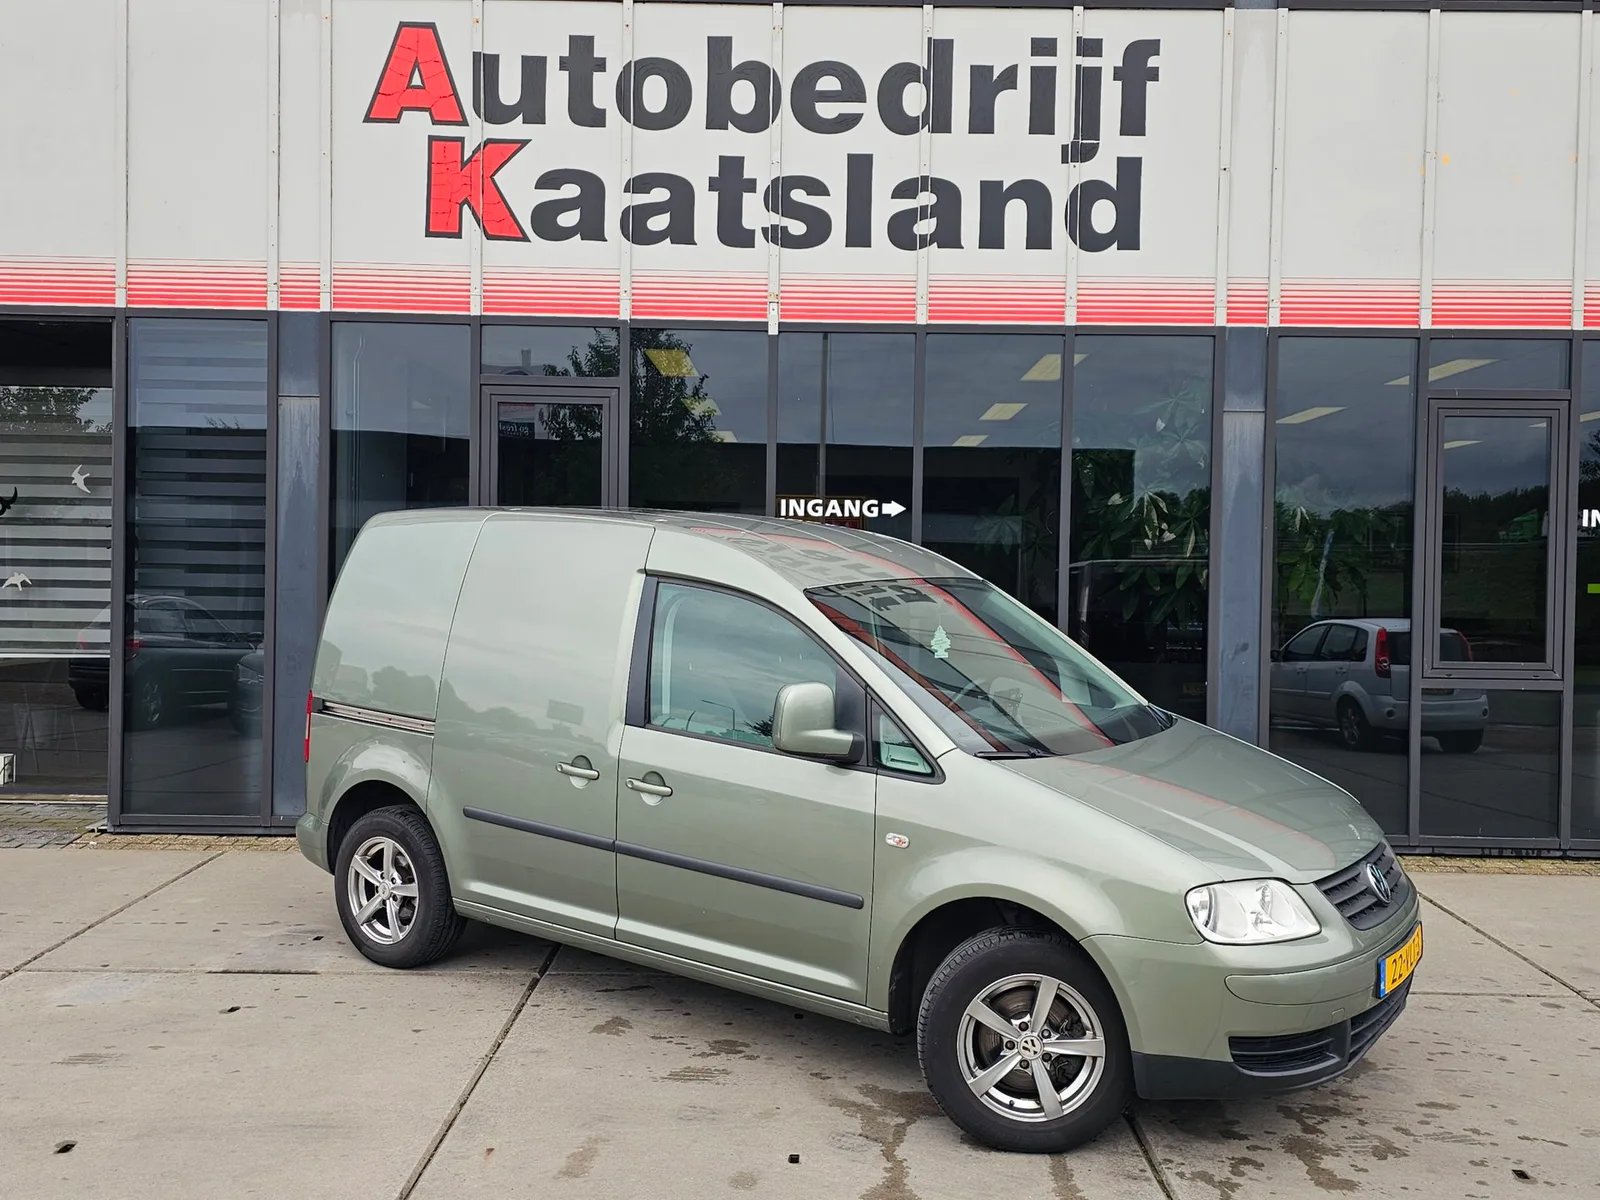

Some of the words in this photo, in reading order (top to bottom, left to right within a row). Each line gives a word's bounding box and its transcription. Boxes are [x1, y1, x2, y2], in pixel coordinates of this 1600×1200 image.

[363, 21, 1160, 164] Autobedrijf
[425, 135, 1142, 252] Kaatsland
[780, 498, 879, 518] INGANG
